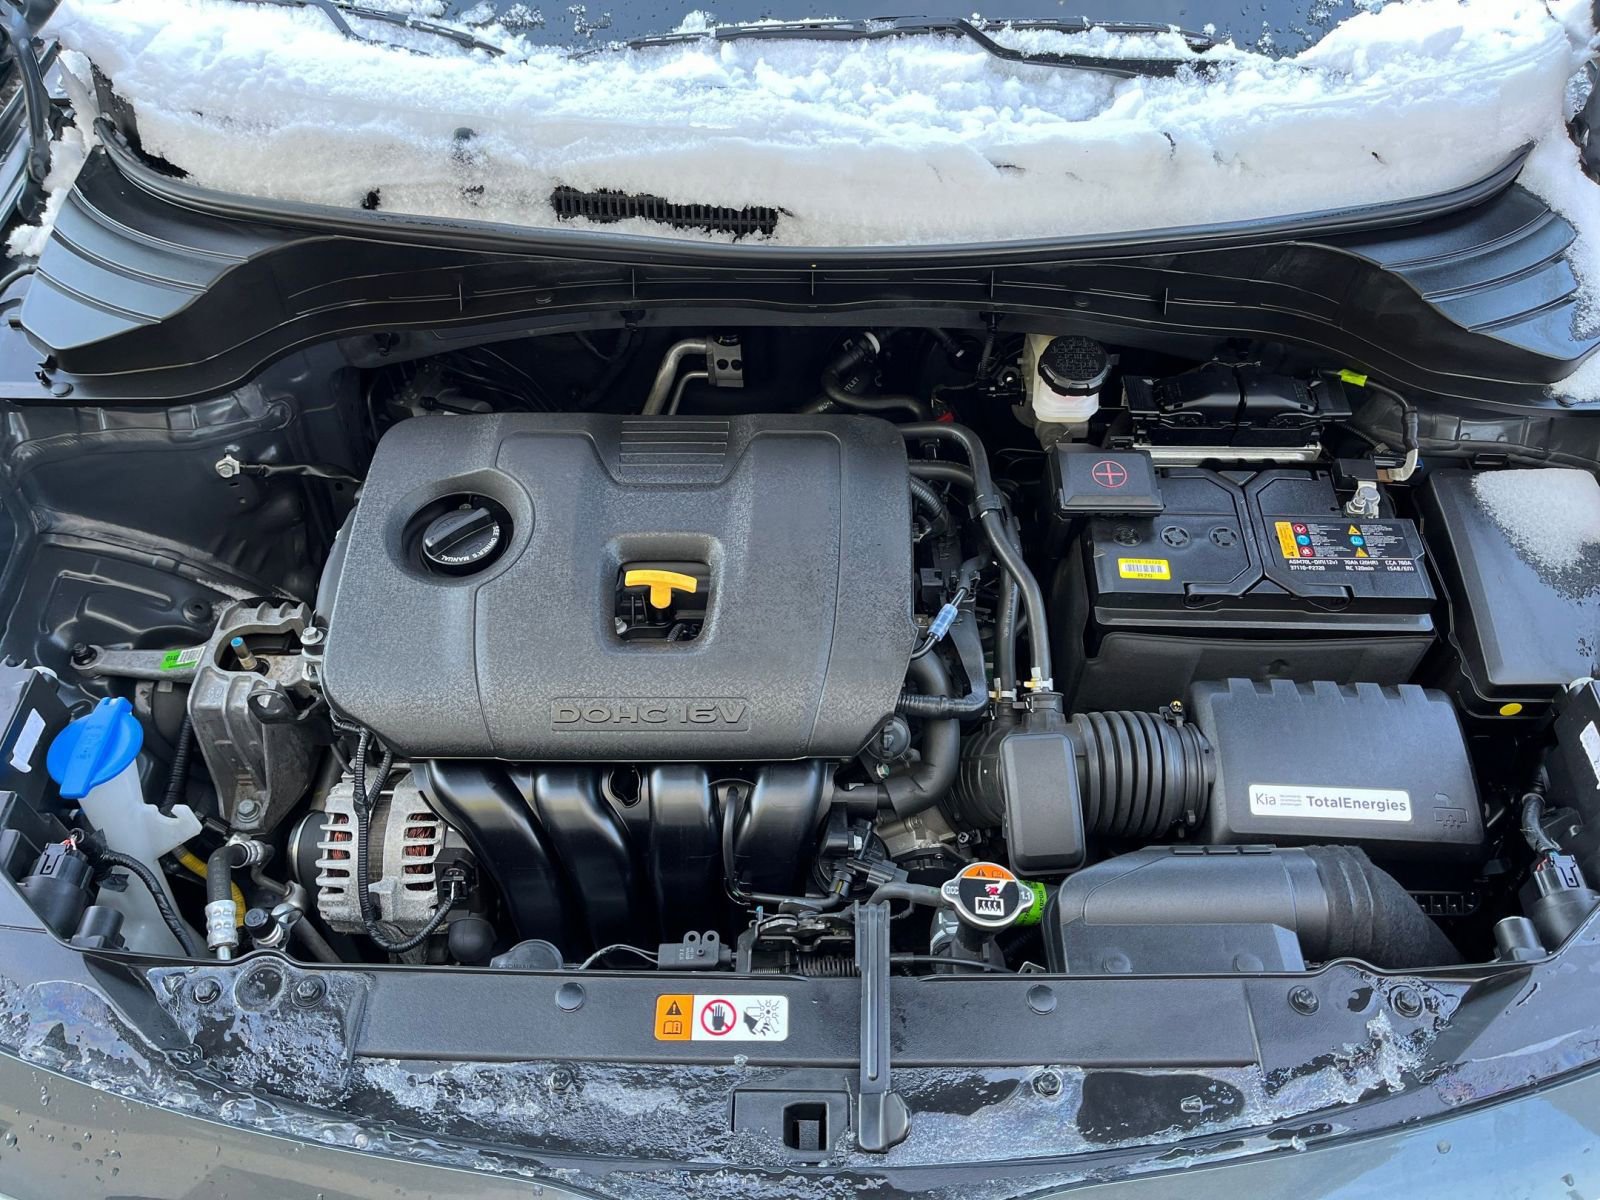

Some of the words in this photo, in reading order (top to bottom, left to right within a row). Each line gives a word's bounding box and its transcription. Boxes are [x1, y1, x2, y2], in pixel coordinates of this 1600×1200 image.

[492, 525, 500, 536] SEE
[471, 537, 498, 559] OWNER'S
[441, 554, 470, 562] MANUAL
[553, 704, 668, 724] DOHC
[679, 704, 746, 724] 16V
[1255, 792, 1276, 806] Kia
[1306, 795, 1407, 812] TotalEnergies
[1020, 891, 1031, 900] 1.1
